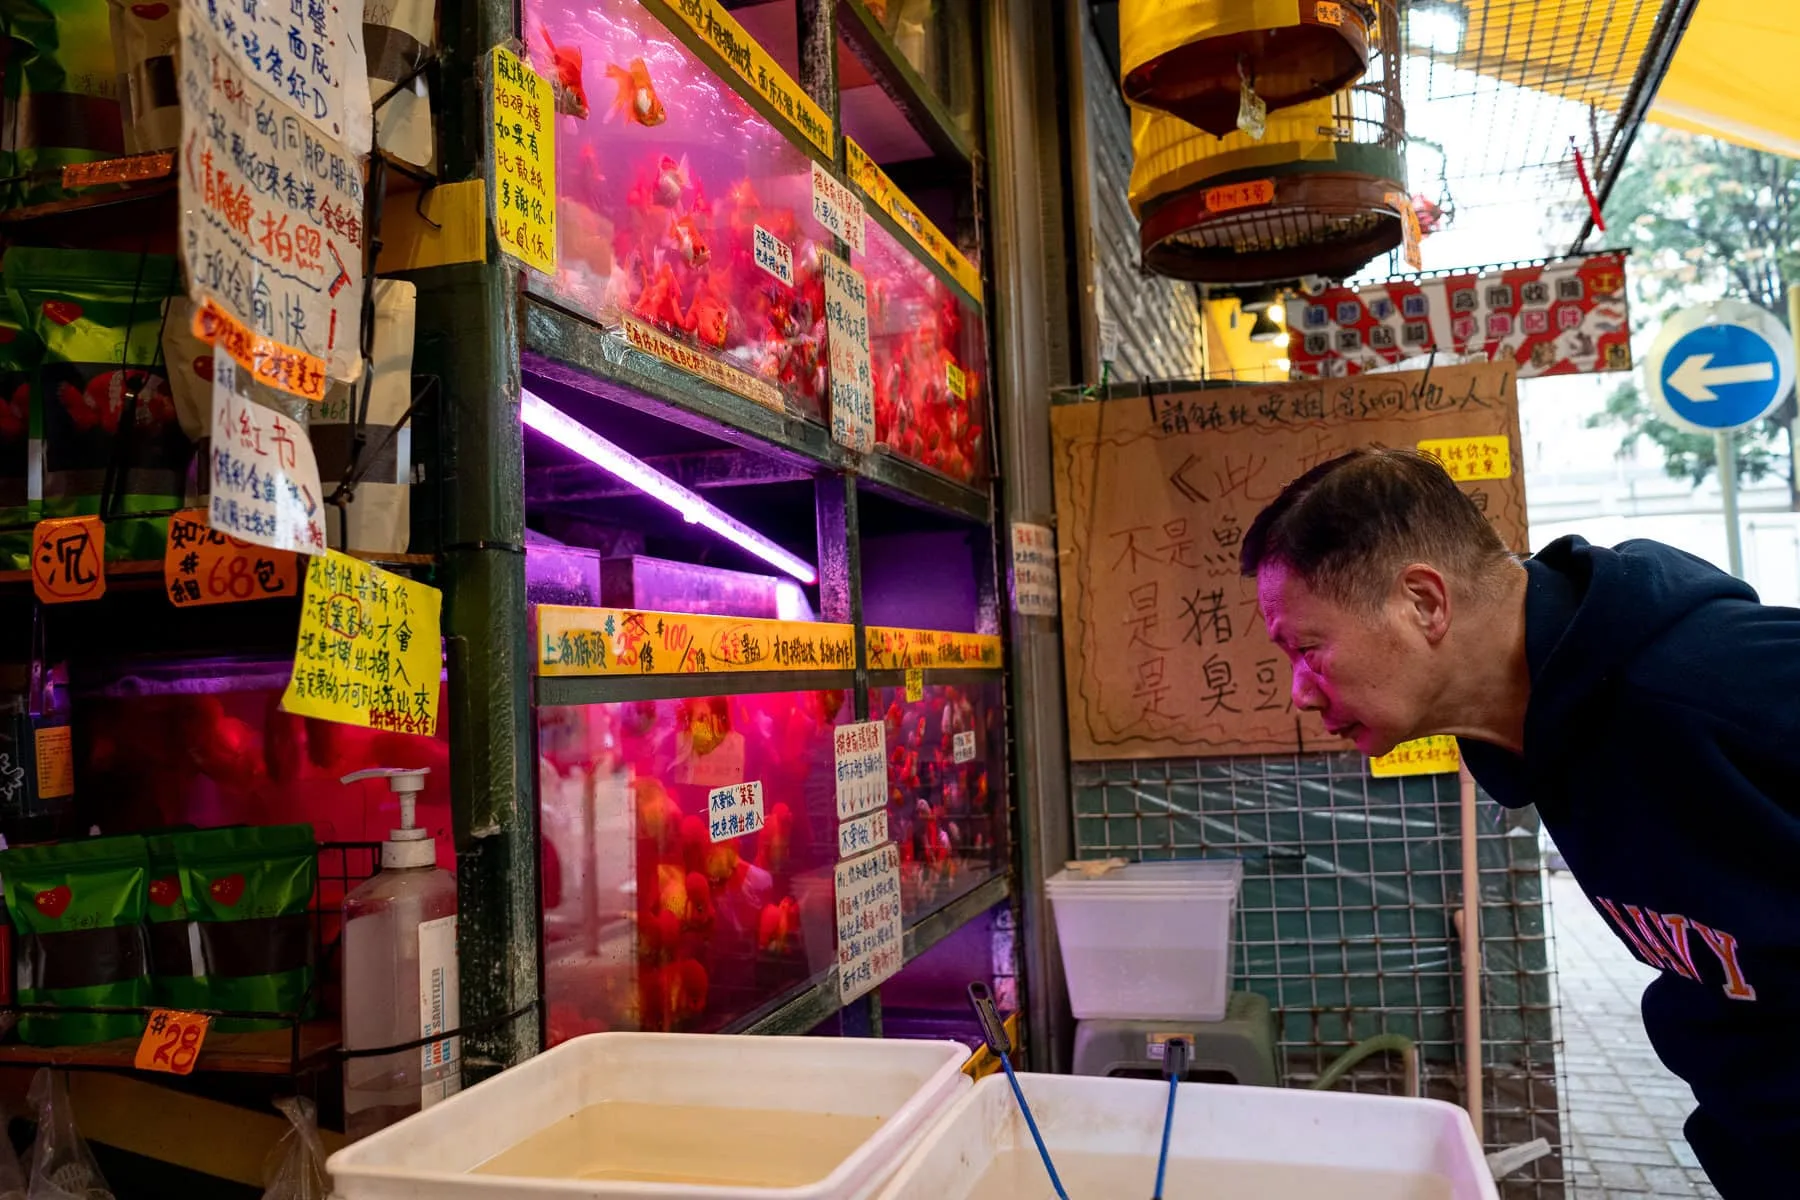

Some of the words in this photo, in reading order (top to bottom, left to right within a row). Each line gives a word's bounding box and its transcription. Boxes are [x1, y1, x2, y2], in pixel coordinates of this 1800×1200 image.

[496, 116, 539, 161] 如果有
[42, 533, 96, 585] 沉
[431, 967, 441, 1029] SANITIZER
